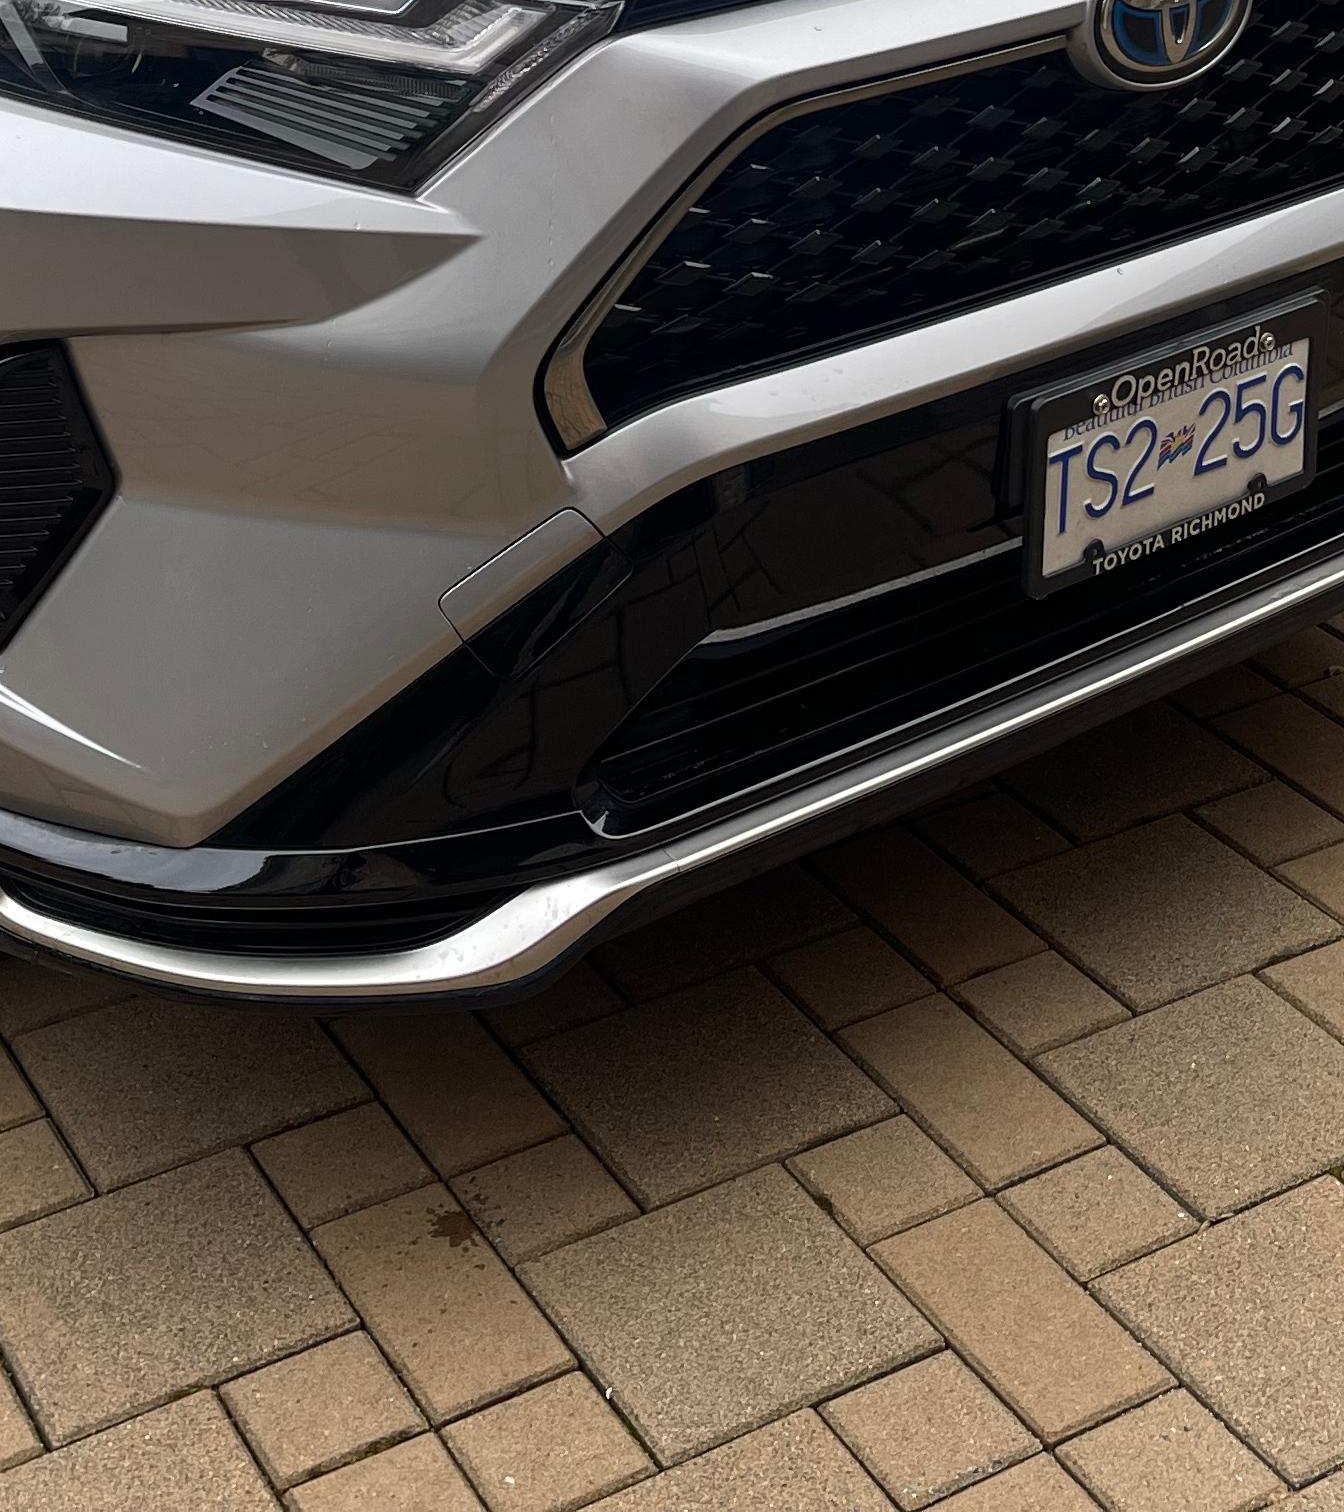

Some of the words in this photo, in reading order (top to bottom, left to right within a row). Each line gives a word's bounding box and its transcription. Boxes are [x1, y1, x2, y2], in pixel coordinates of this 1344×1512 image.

[1111, 325, 1261, 409] OpenRoad
[1048, 416, 1158, 535] TS2
[1193, 363, 1305, 477] 25G
[1092, 534, 1165, 576] TOYOTA
[1171, 492, 1265, 544] RICHMOND
